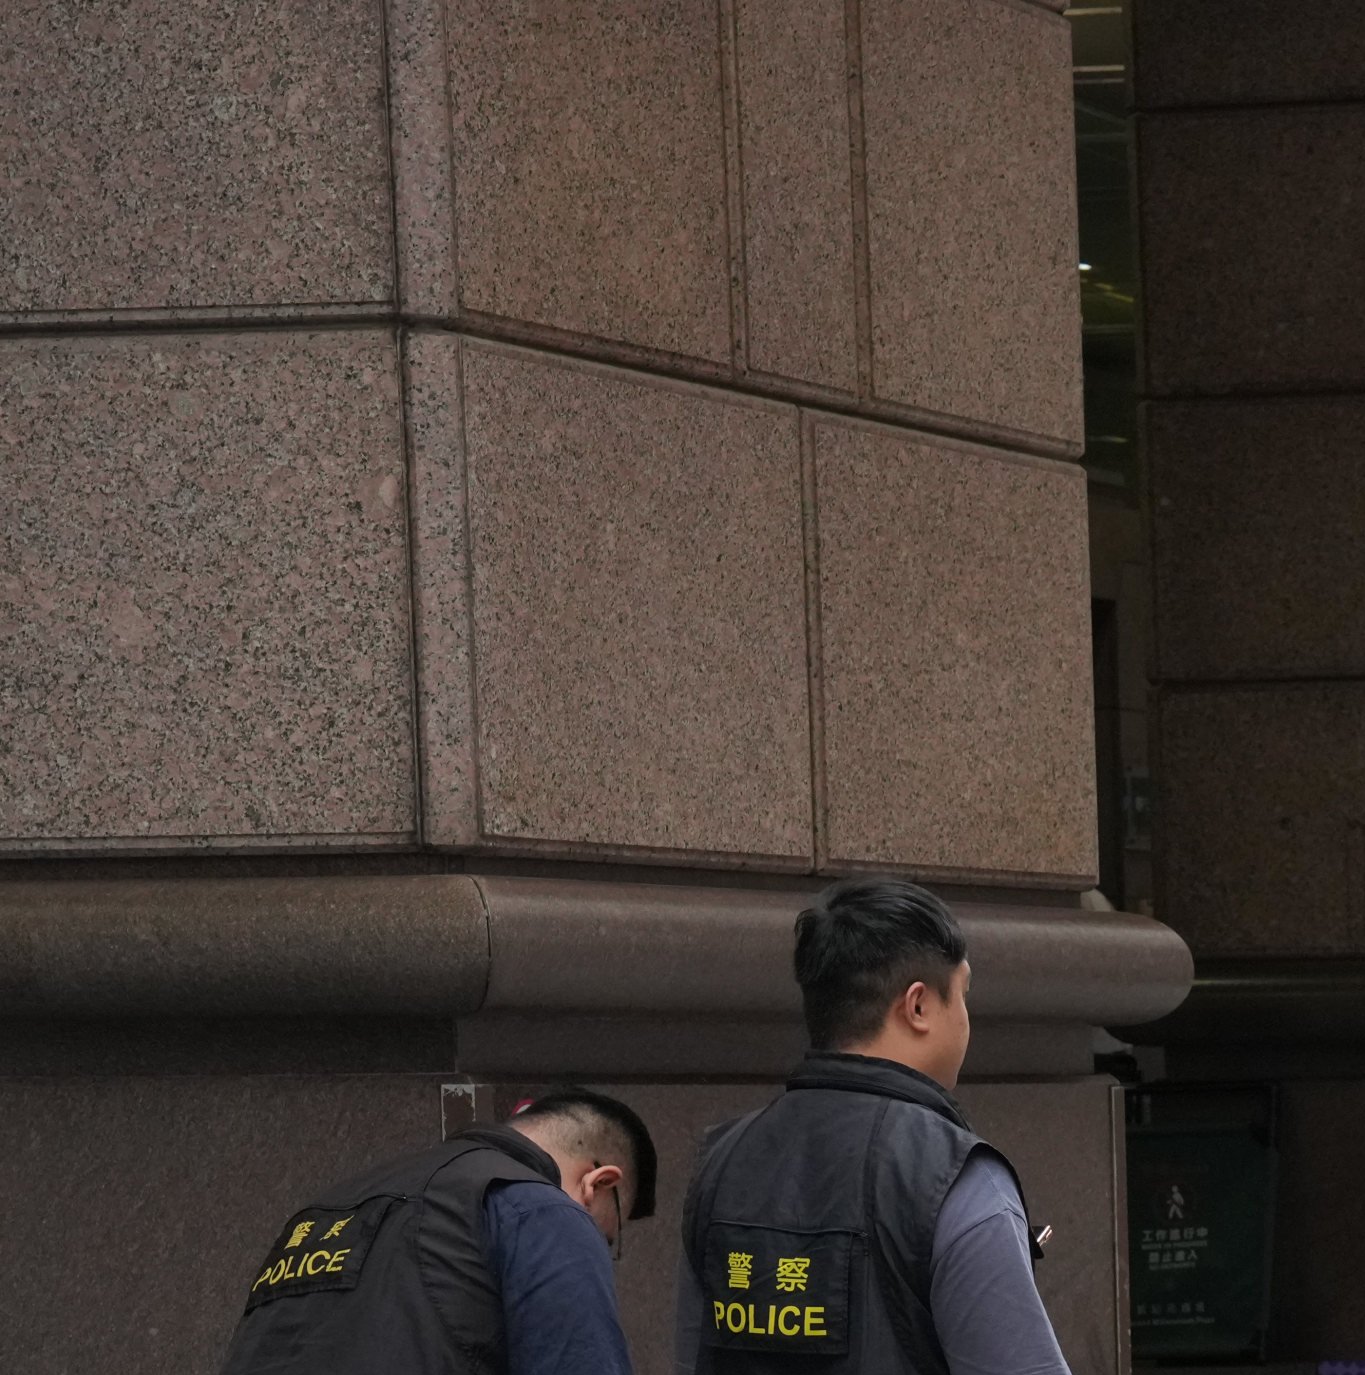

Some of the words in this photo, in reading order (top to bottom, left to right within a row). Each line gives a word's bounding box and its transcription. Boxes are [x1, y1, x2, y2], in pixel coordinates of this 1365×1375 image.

[283, 1215, 356, 1251] 警察
[252, 1247, 351, 1291] POLICE
[726, 1251, 811, 1293] 警察
[713, 1300, 827, 1338] POLICE
